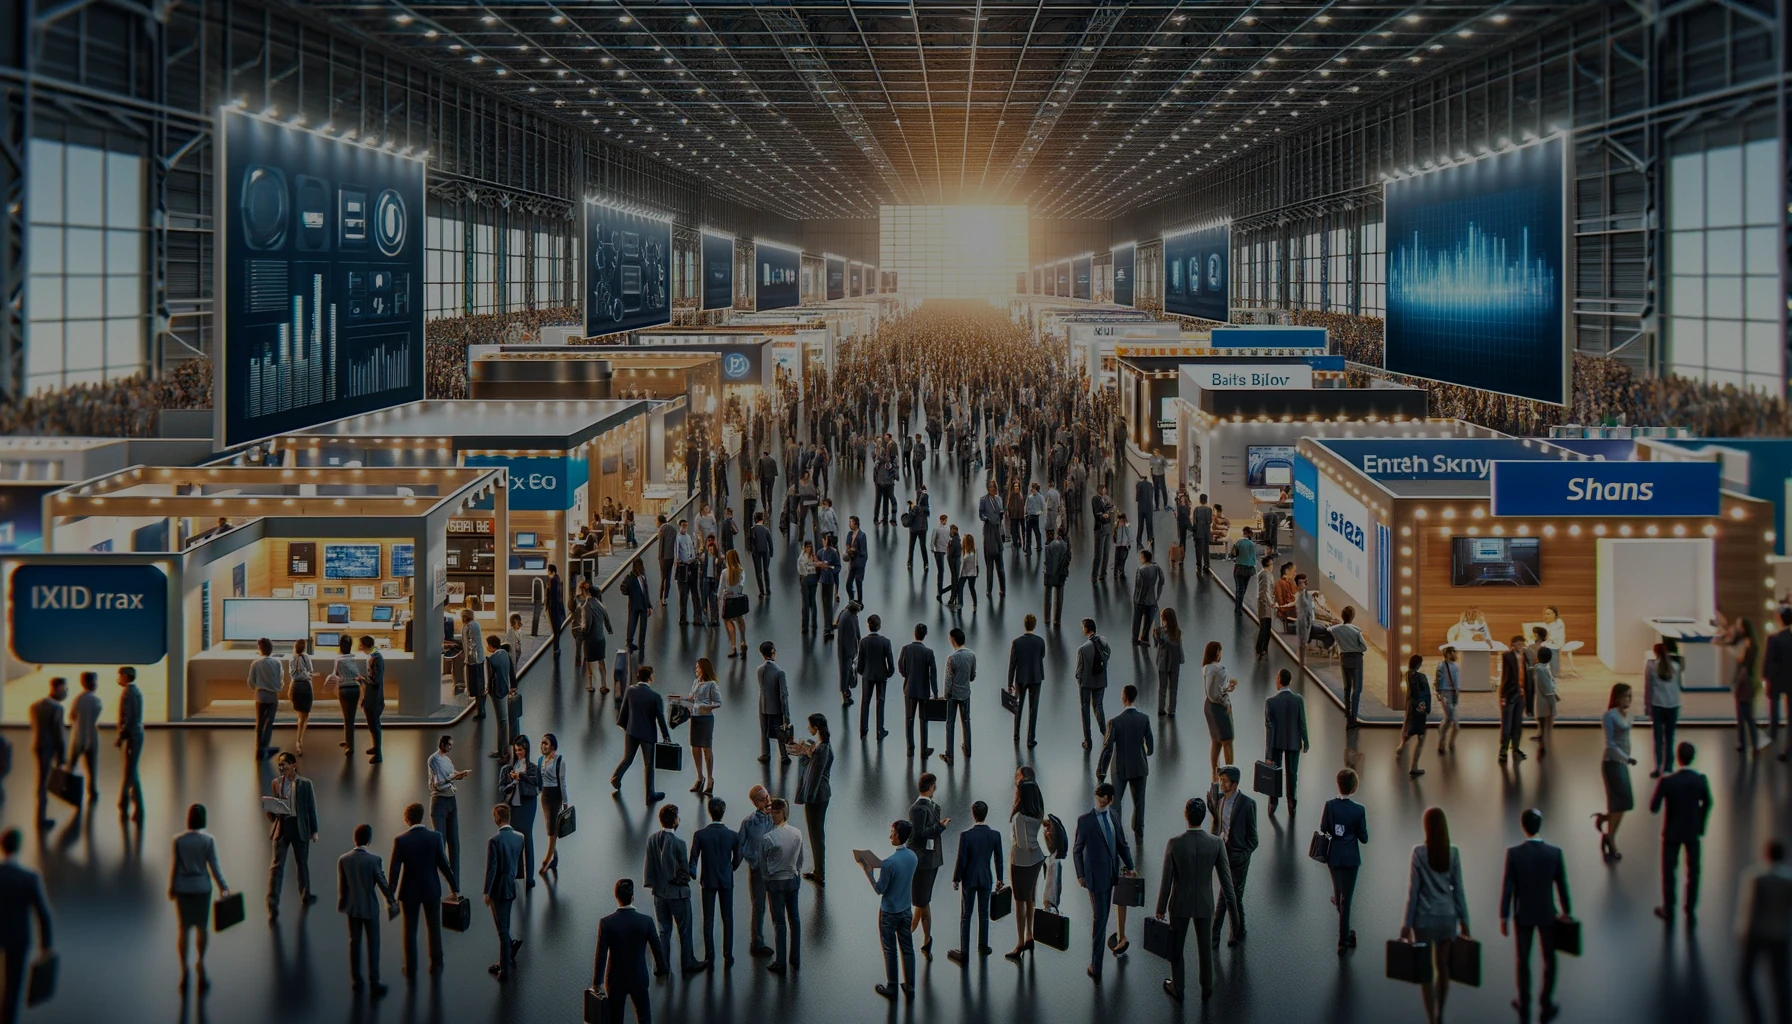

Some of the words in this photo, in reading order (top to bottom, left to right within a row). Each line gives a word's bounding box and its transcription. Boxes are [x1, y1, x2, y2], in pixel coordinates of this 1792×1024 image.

[1566, 477, 1654, 501] Shans
[31, 585, 92, 610] IXID
[95, 592, 144, 610] rrax
